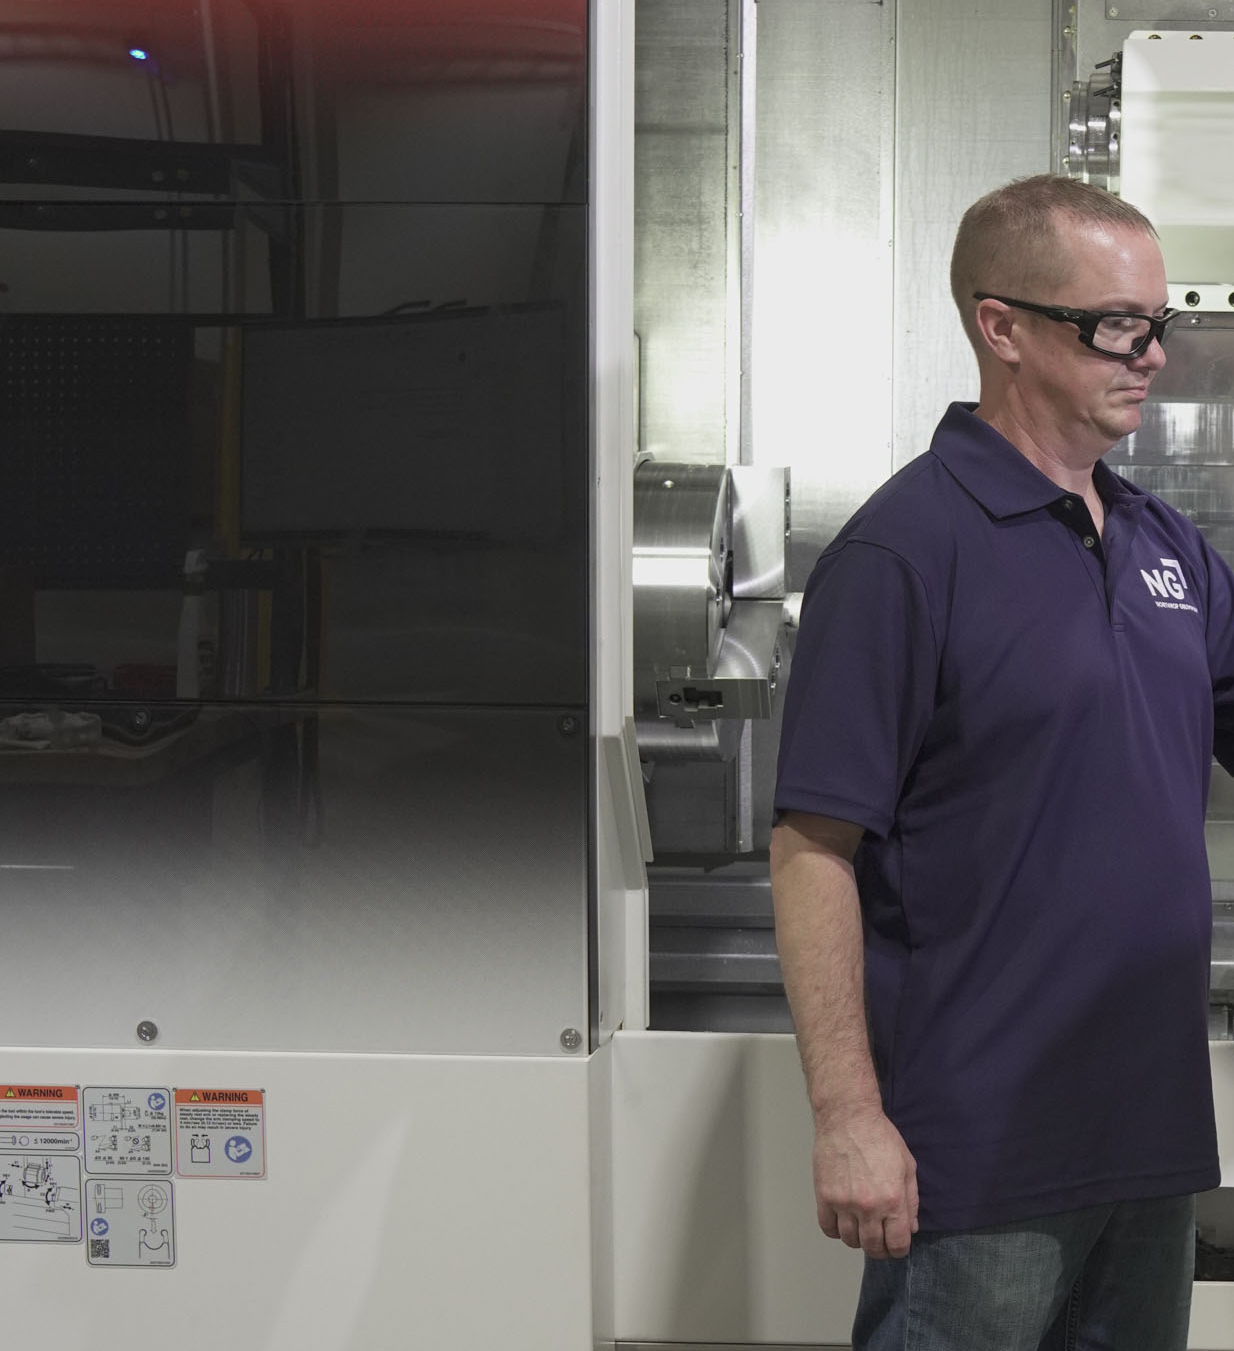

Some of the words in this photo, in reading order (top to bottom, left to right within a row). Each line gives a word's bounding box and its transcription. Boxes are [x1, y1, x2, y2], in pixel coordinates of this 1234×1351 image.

[1140, 569, 1184, 600] NG
[18, 1089, 63, 1097] WARNING
[202, 1092, 248, 1102] WARNING
